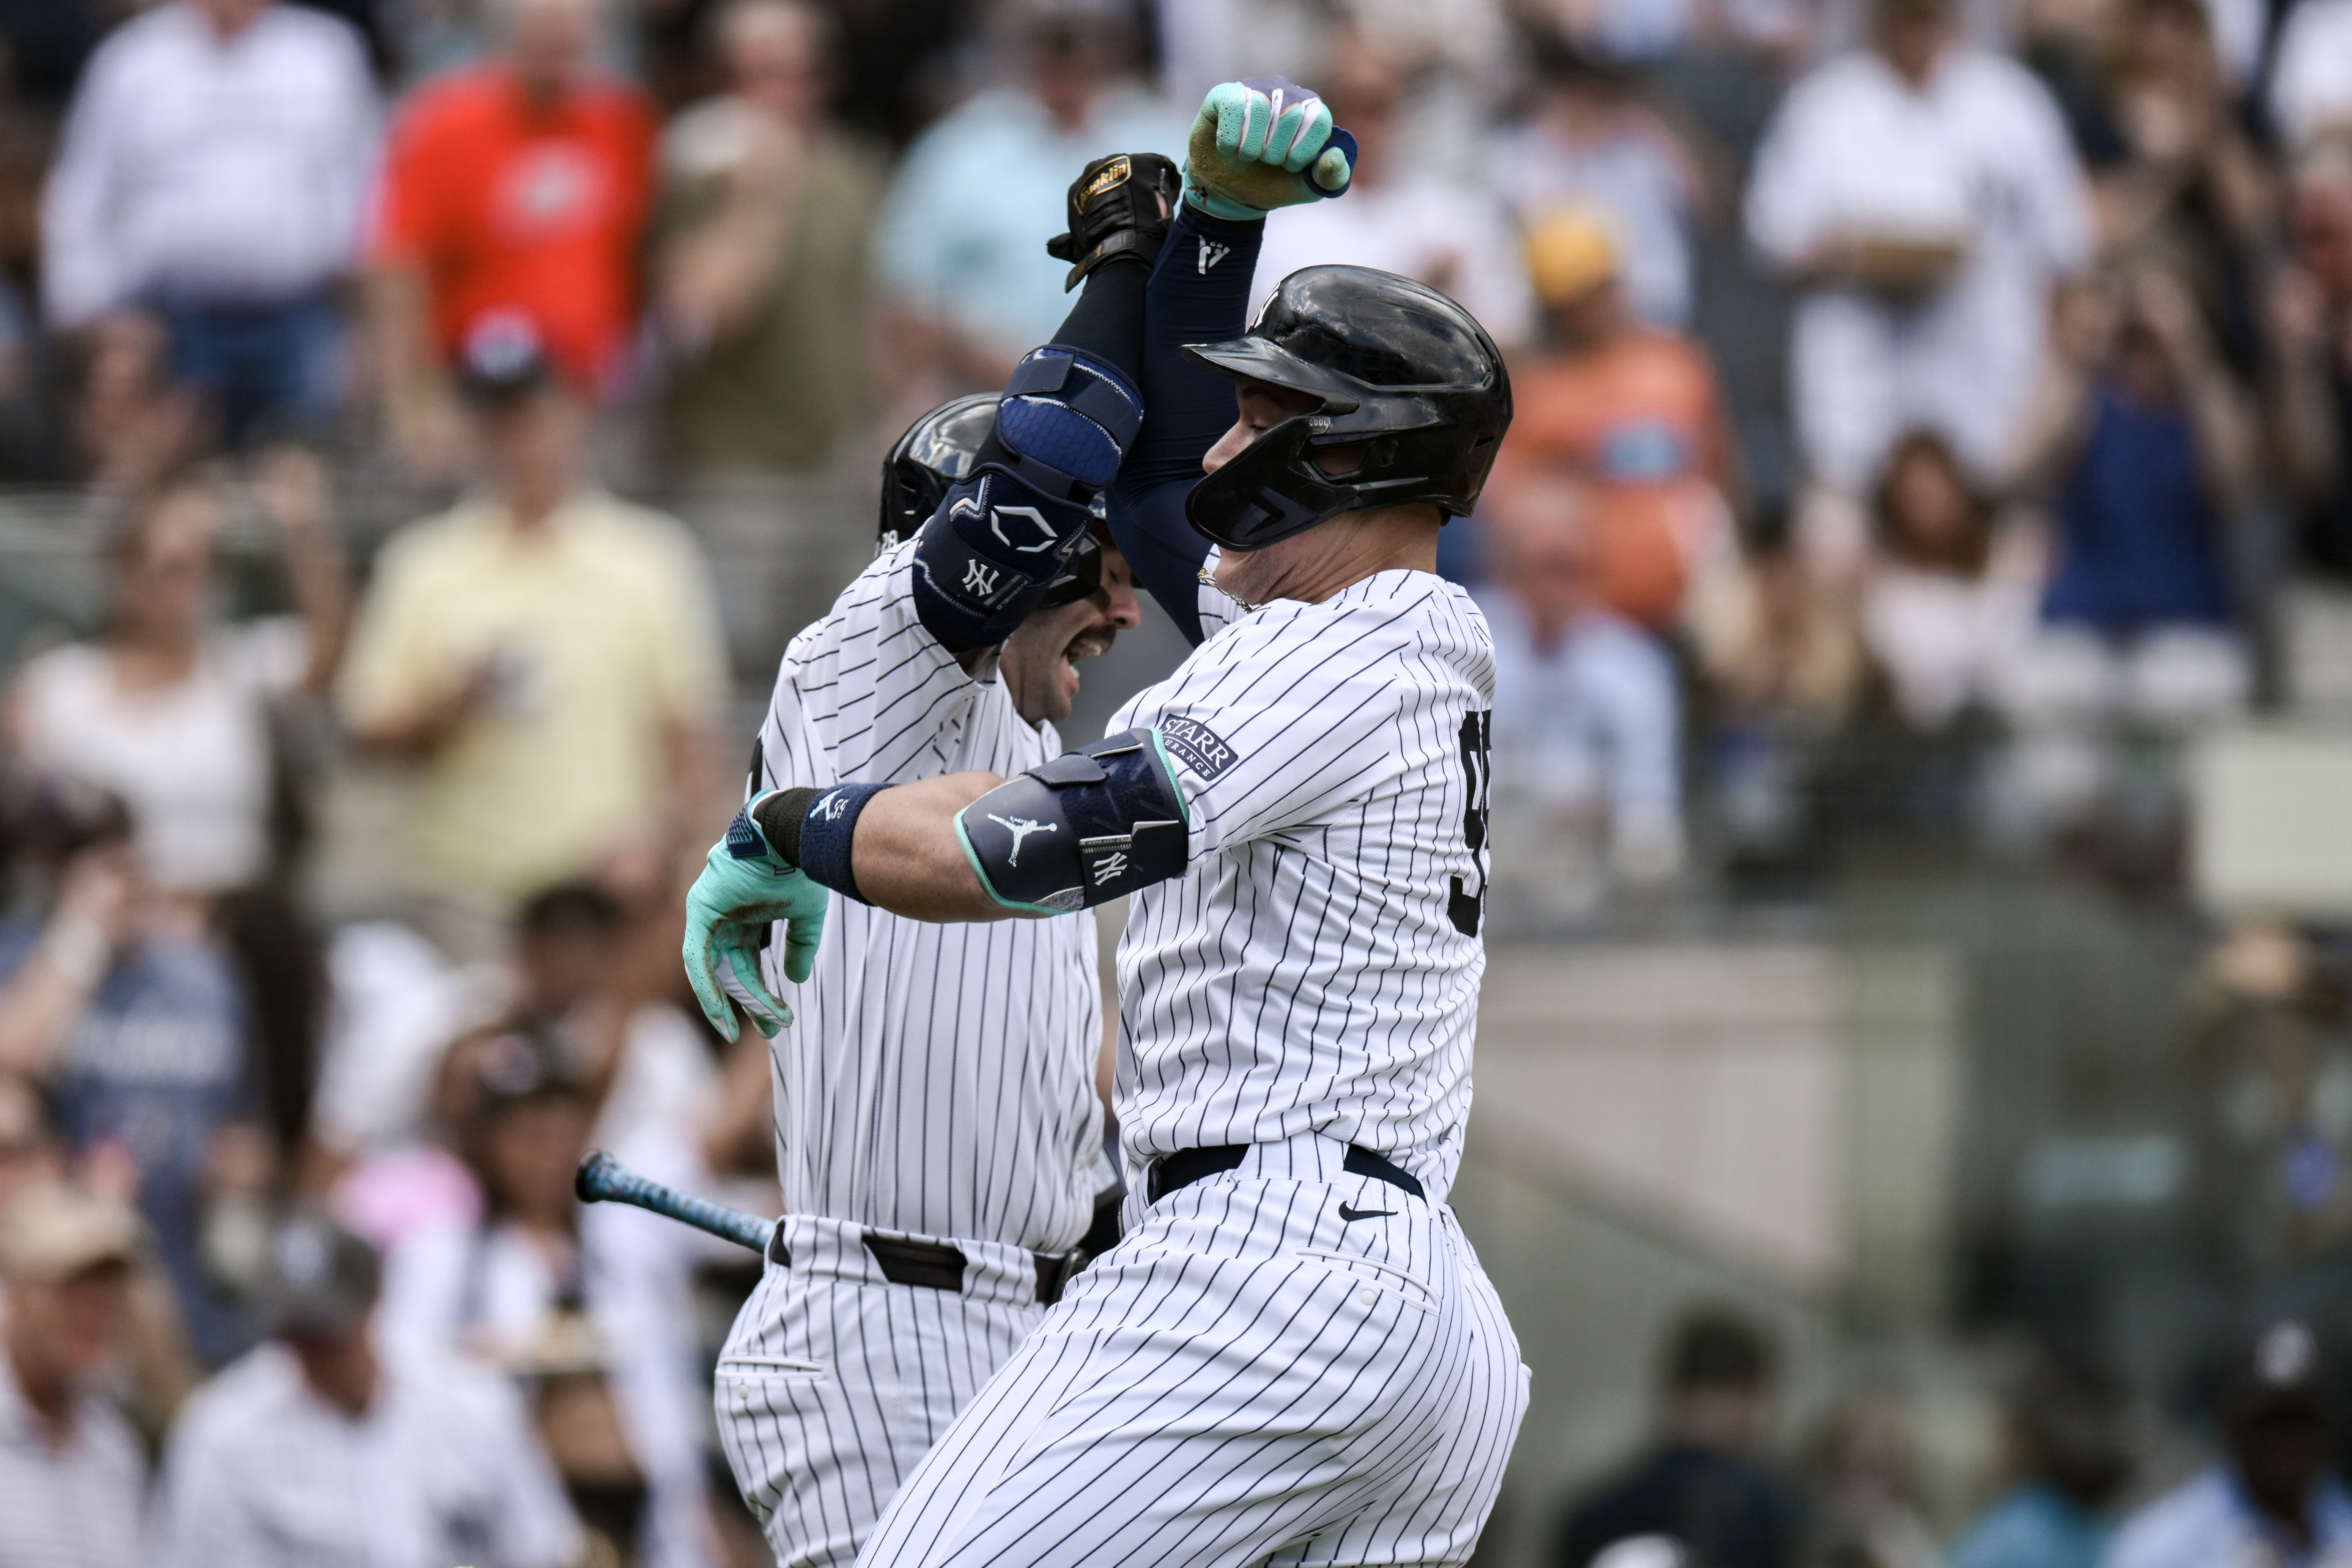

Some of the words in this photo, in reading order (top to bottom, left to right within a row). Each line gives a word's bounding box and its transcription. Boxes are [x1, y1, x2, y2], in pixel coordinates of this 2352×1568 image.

[962, 559, 1000, 597] NY
[1160, 719, 1229, 769] STARR
[1163, 738, 1211, 777] URANCE
[1447, 708, 1492, 938] 9
[1093, 852, 1127, 886] NY
